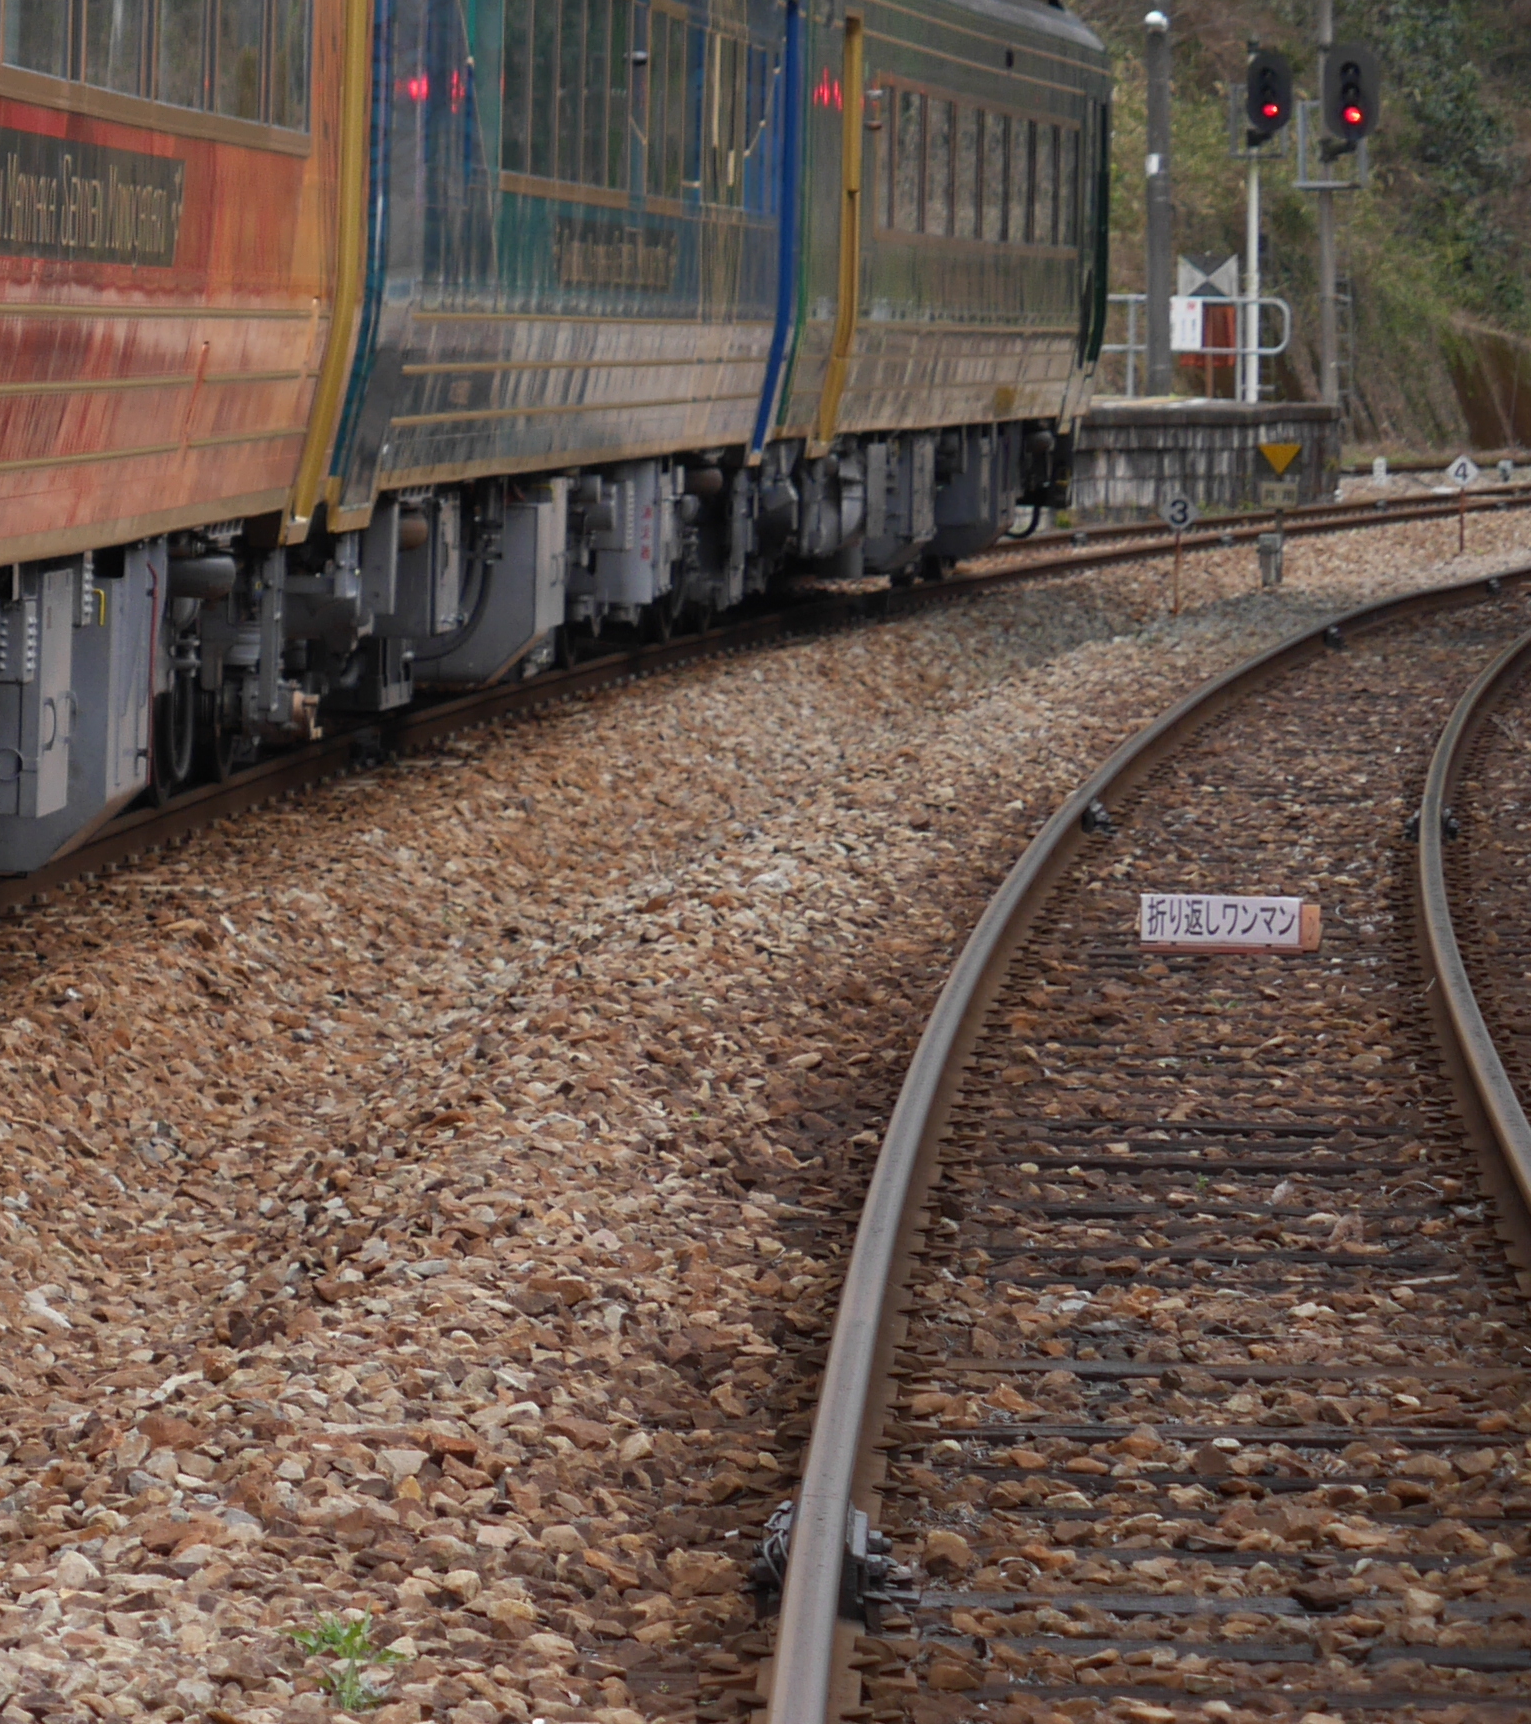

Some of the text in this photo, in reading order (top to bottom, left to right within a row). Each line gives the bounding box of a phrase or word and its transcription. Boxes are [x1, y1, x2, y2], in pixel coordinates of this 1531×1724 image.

[1454, 462, 1468, 481] 4
[1170, 499, 1188, 525] 3
[1147, 896, 1296, 937] 折り返しワンマン
